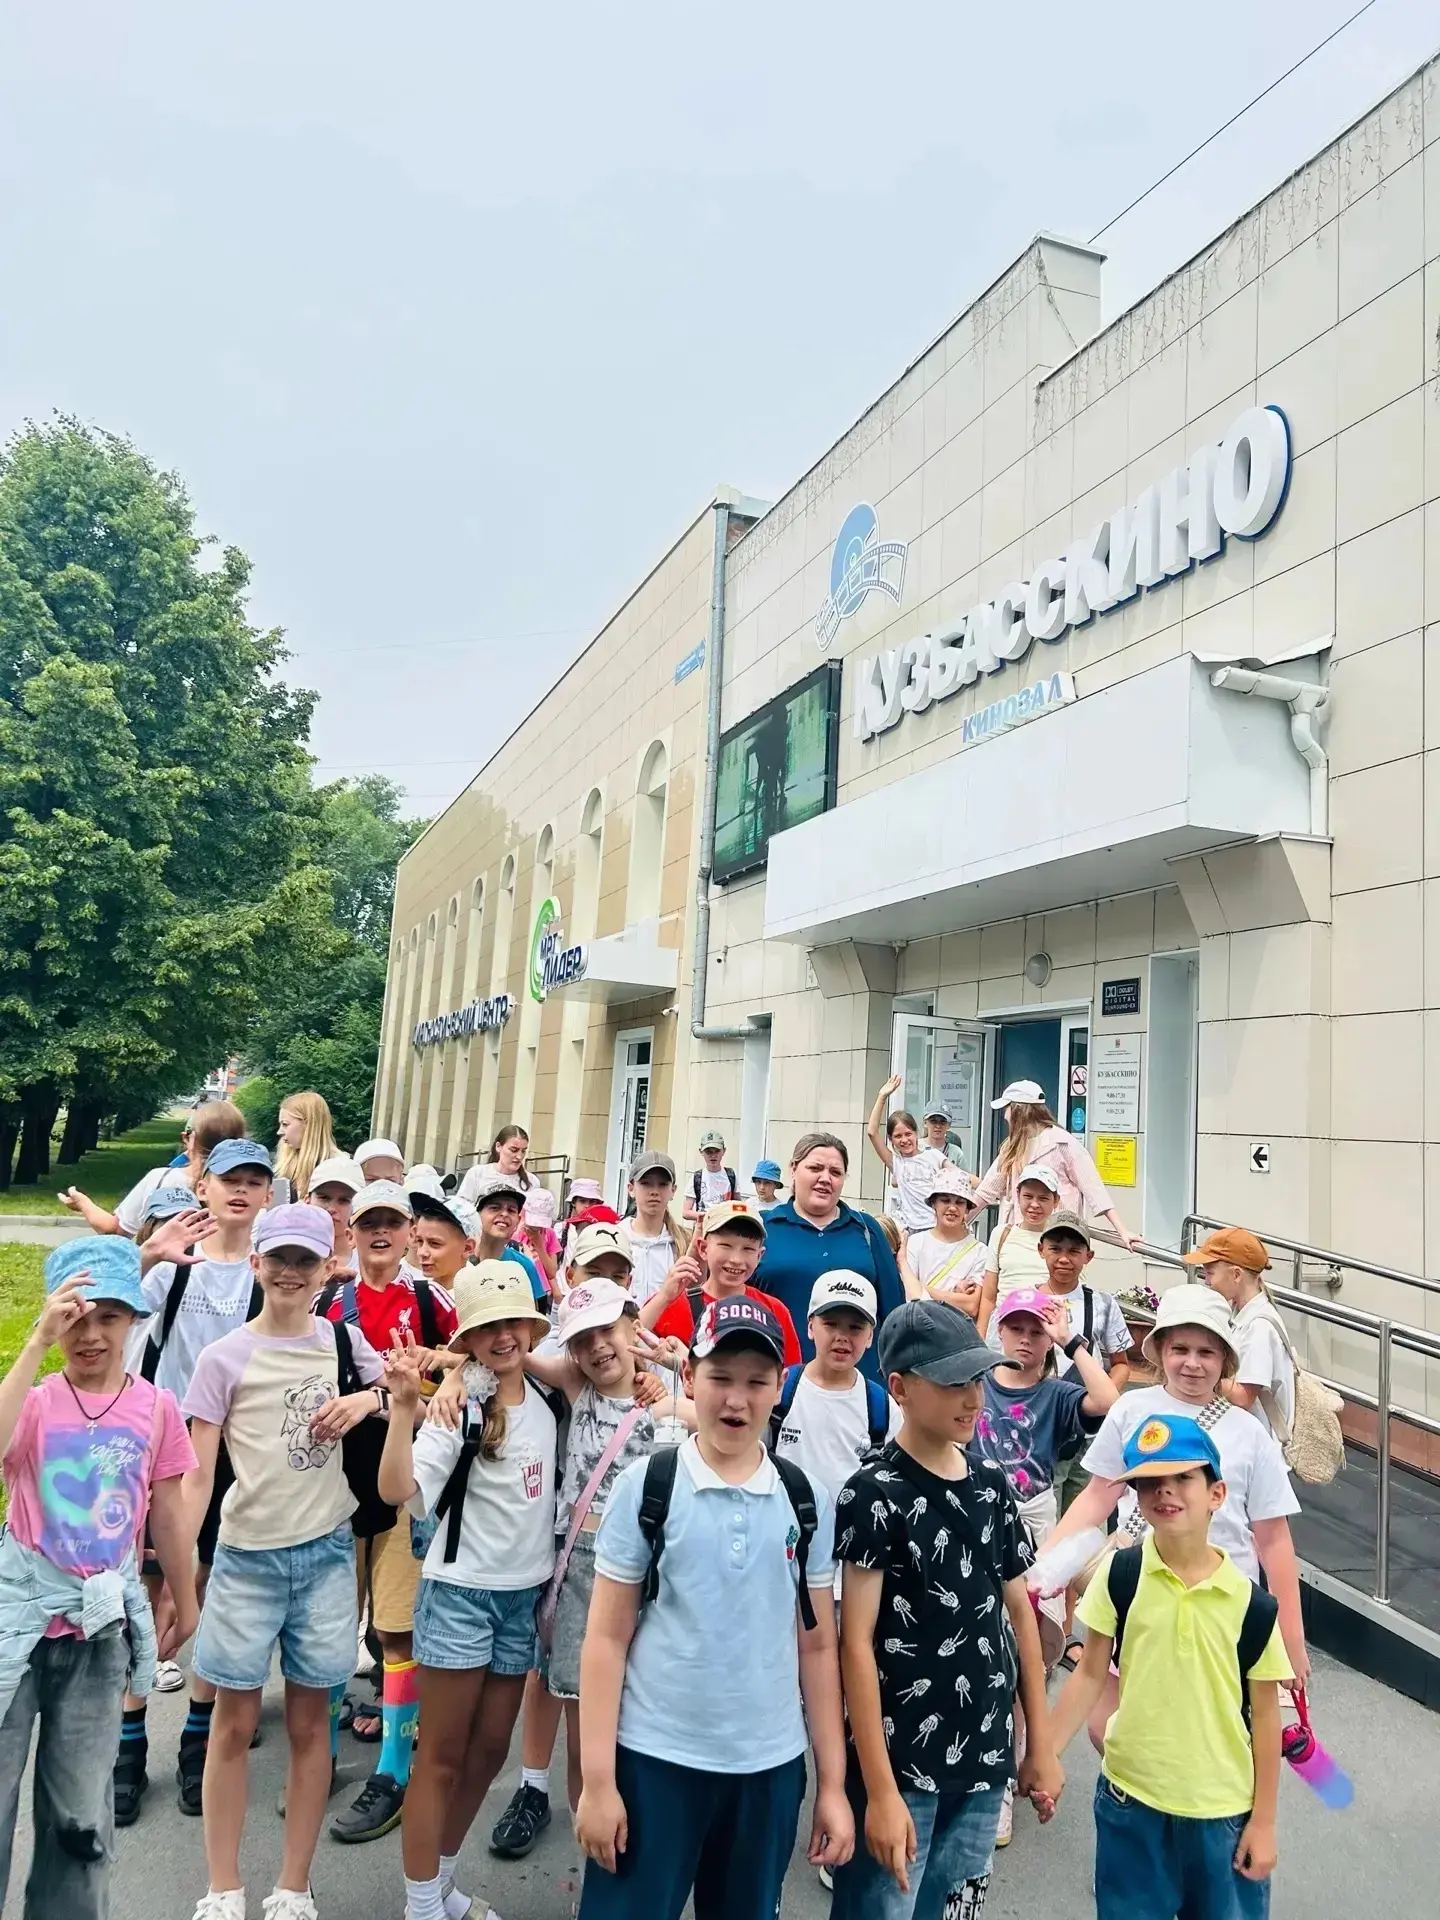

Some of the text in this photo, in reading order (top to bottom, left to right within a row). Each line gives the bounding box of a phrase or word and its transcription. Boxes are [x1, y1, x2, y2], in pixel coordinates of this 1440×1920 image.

[854, 405, 1292, 741] КУЗБАССКИНО
[962, 672, 1068, 744] КИНОЗАЛ
[540, 932, 559, 960] МРТ
[543, 945, 582, 986] ЛИДЕР
[477, 994, 509, 1030] ЦЕНТР
[1104, 996, 1136, 1005] DIGITAL
[1097, 1070, 1138, 1078] КУЗБАССКИНО
[719, 1304, 768, 1327] SOCHI
